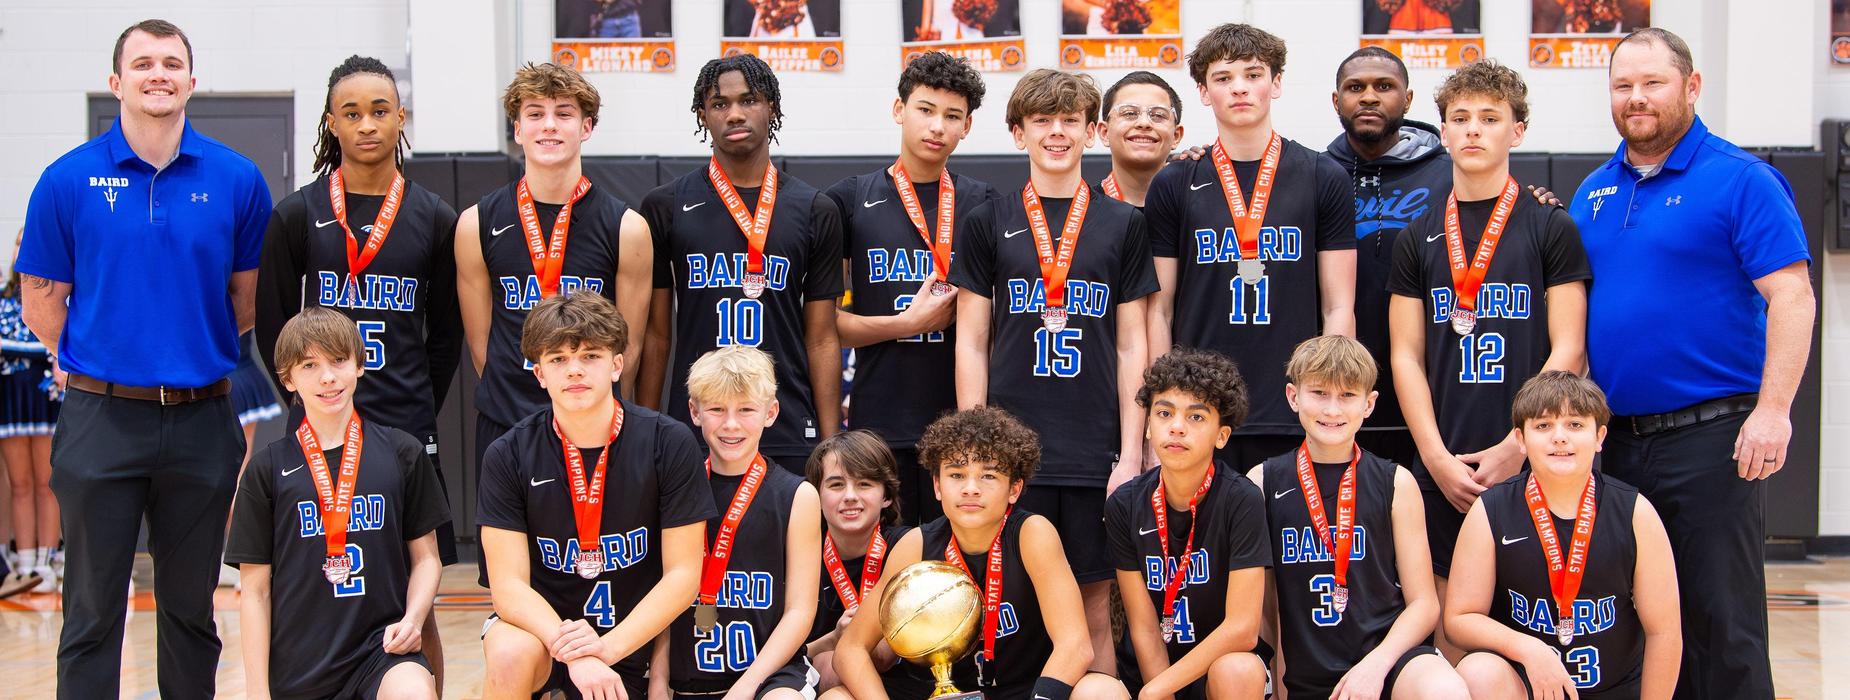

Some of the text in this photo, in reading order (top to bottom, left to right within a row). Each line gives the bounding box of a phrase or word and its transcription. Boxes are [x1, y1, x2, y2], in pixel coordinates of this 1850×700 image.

[89, 177, 129, 187] BAIRD
[1220, 163, 1246, 218] CHAMPIONS
[1250, 134, 1281, 220] STATE CHAMPIONS
[1588, 186, 1618, 200] BAIRD
[368, 221, 388, 249] STATE
[521, 203, 546, 260] CHAMPIONS
[550, 229, 565, 258] STATE
[754, 207, 769, 235] STATE
[939, 193, 952, 244] CHAMPIONS
[1030, 208, 1054, 264] CHAMPIONS
[1057, 184, 1089, 268] STATE CHAMPIONS
[1447, 213, 1465, 269] CHAMPIONS
[1474, 182, 1517, 269] STATE CHAMPIONS
[1195, 226, 1302, 264] BARD
[686, 252, 791, 291] BAID
[716, 298, 764, 347] 10
[1008, 278, 1110, 318] BARD
[1229, 274, 1271, 325] 11
[1033, 327, 1083, 378] 15
[1459, 332, 1505, 383] 12
[300, 423, 334, 511] STATE CHAMPIONS
[336, 420, 360, 512] STATE CHAMPIONS
[565, 439, 588, 502] HAMPIONS
[589, 471, 603, 504] STATE
[715, 463, 764, 559] STATE CHAMPIONS
[1298, 450, 1330, 544] STATE CHAMPIONS
[1339, 507, 1351, 539] STATE
[1534, 508, 1562, 571] CHAMPIONS
[537, 526, 648, 575] BARD
[1569, 540, 1586, 573] STATE
[583, 581, 616, 628] 4
[988, 578, 1000, 611] STATE
[1310, 574, 1343, 626] 3
[1508, 589, 1616, 636] BARD
[694, 620, 757, 672] 20
